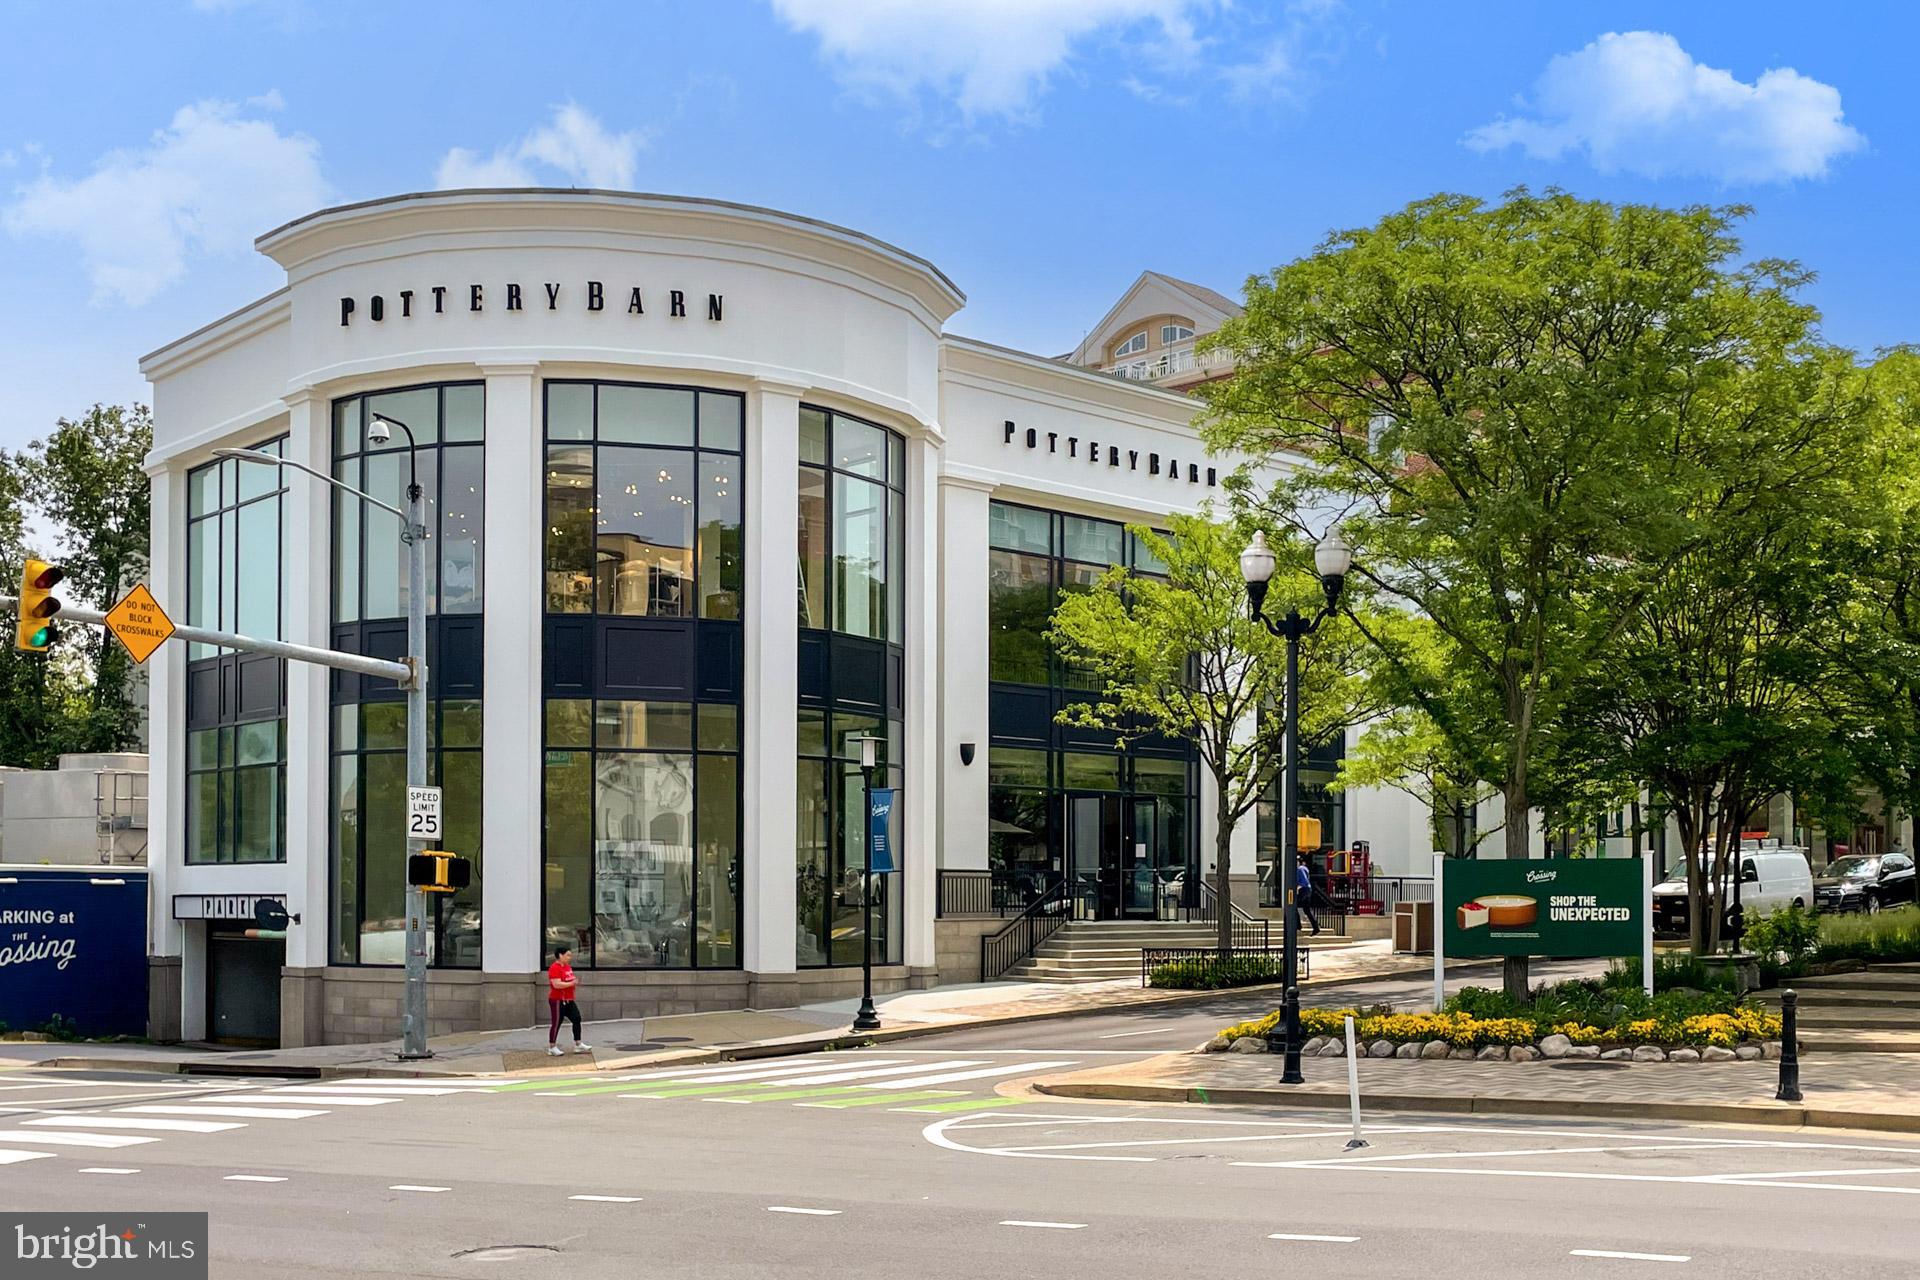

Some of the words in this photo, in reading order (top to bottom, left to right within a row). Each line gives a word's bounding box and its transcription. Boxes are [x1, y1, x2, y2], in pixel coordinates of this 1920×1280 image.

[126, 600, 138, 609] DO
[141, 602, 156, 612] NOT
[129, 613, 153, 624] BLOCK
[116, 624, 165, 638] CROSSWALKS
[410, 792, 439, 802] SPEED
[413, 803, 435, 811] LIMIT
[411, 814, 437, 833] 25
[1550, 896, 1577, 907] SHOP
[1578, 896, 1596, 907] THE
[0, 910, 55, 924] RKING
[59, 911, 74, 924] at
[1550, 907, 1630, 922] UNEXPECTED
[12, 932, 28, 941] THE
